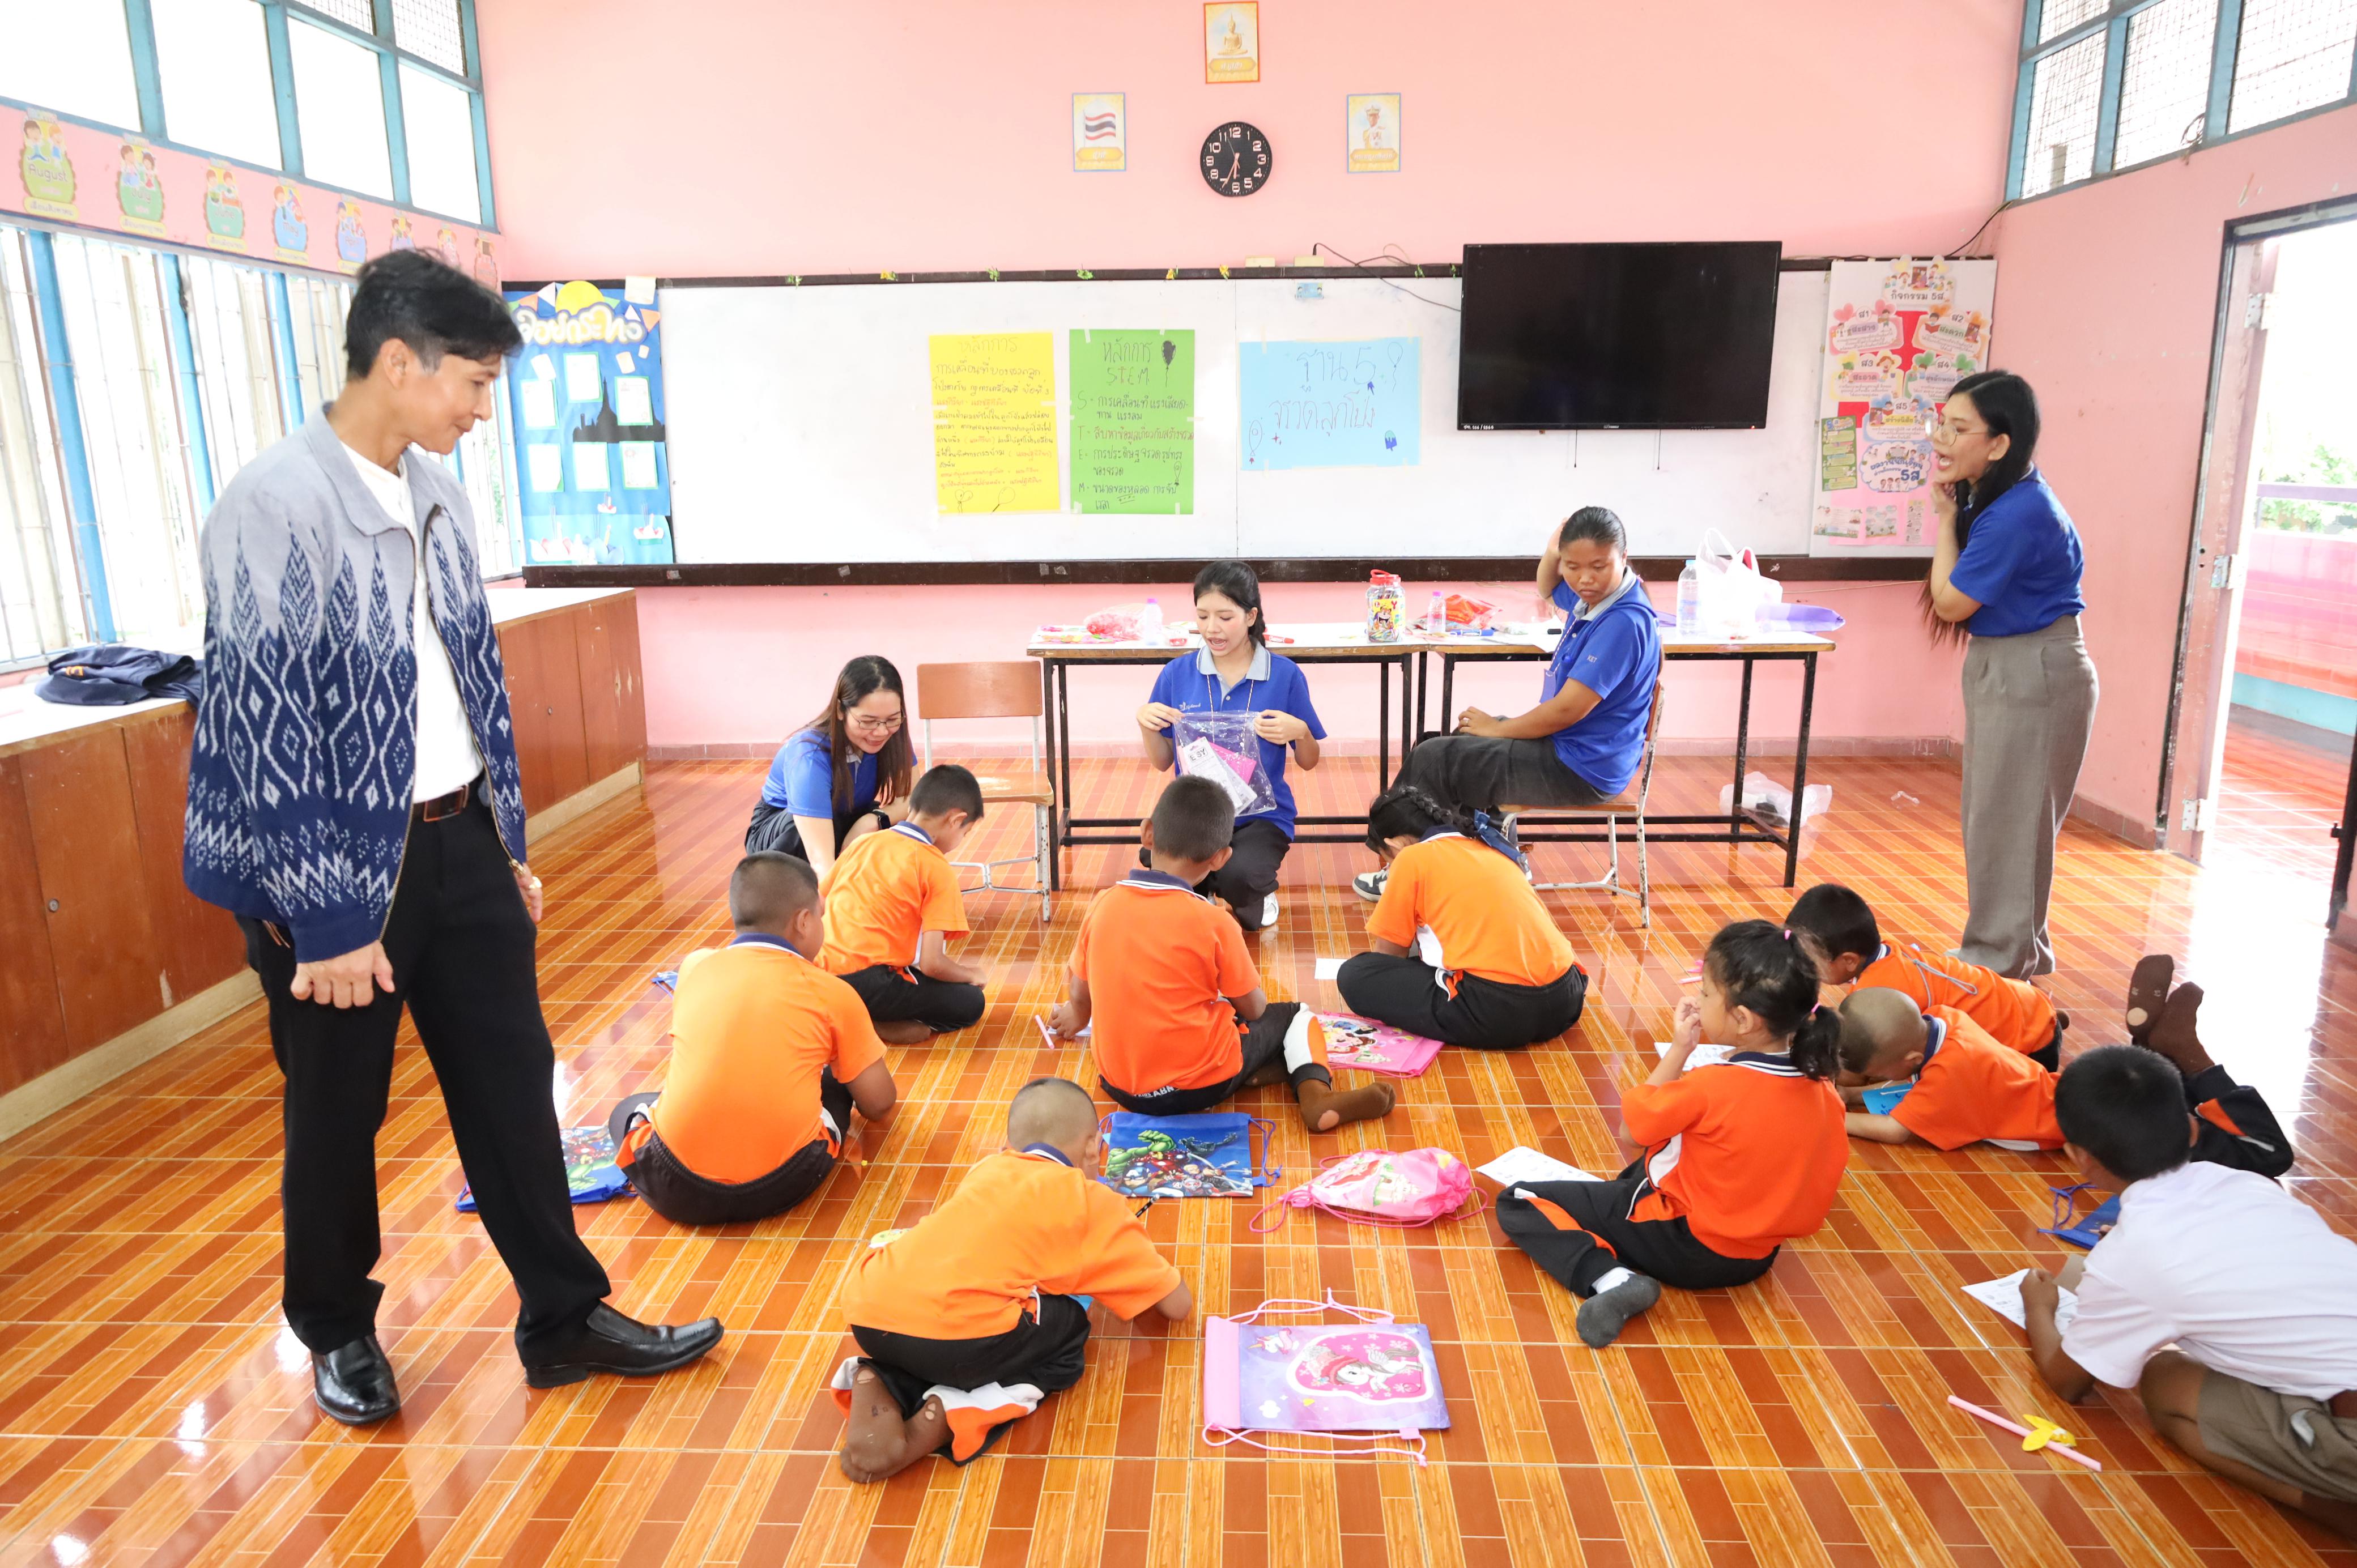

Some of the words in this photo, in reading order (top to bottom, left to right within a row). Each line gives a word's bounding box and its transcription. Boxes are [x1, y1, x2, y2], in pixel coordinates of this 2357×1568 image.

[1219, 131, 1227, 142] 11
[1229, 126, 1241, 138] 12
[1246, 130, 1250, 141] 1
[1209, 142, 1221, 153] 10
[1252, 140, 1262, 152] 2
[1206, 155, 1214, 167] 9
[1257, 154, 1266, 165] 3
[29, 163, 69, 182] August
[1210, 168, 1219, 180] 8
[1253, 167, 1262, 178] 4
[1232, 181, 1240, 193] 6
[1244, 177, 1253, 189] 5
[131, 189, 151, 204] July
[283, 221, 300, 237] May
[1891, 289, 1928, 300] กิจกรรม
[1858, 309, 1869, 318] ส1
[1951, 314, 1964, 323] ส2
[1939, 326, 1964, 337] สะดวก
[1103, 337, 1153, 363] หลักการ
[1296, 349, 1348, 393] ฐาน
[1354, 347, 1377, 385] 5
[1117, 410, 1143, 421] แรงลม
[1268, 390, 1375, 437] จรวดลูกโป่ง
[1901, 469, 1920, 482] 5ส
[1586, 655, 1598, 663] KET
